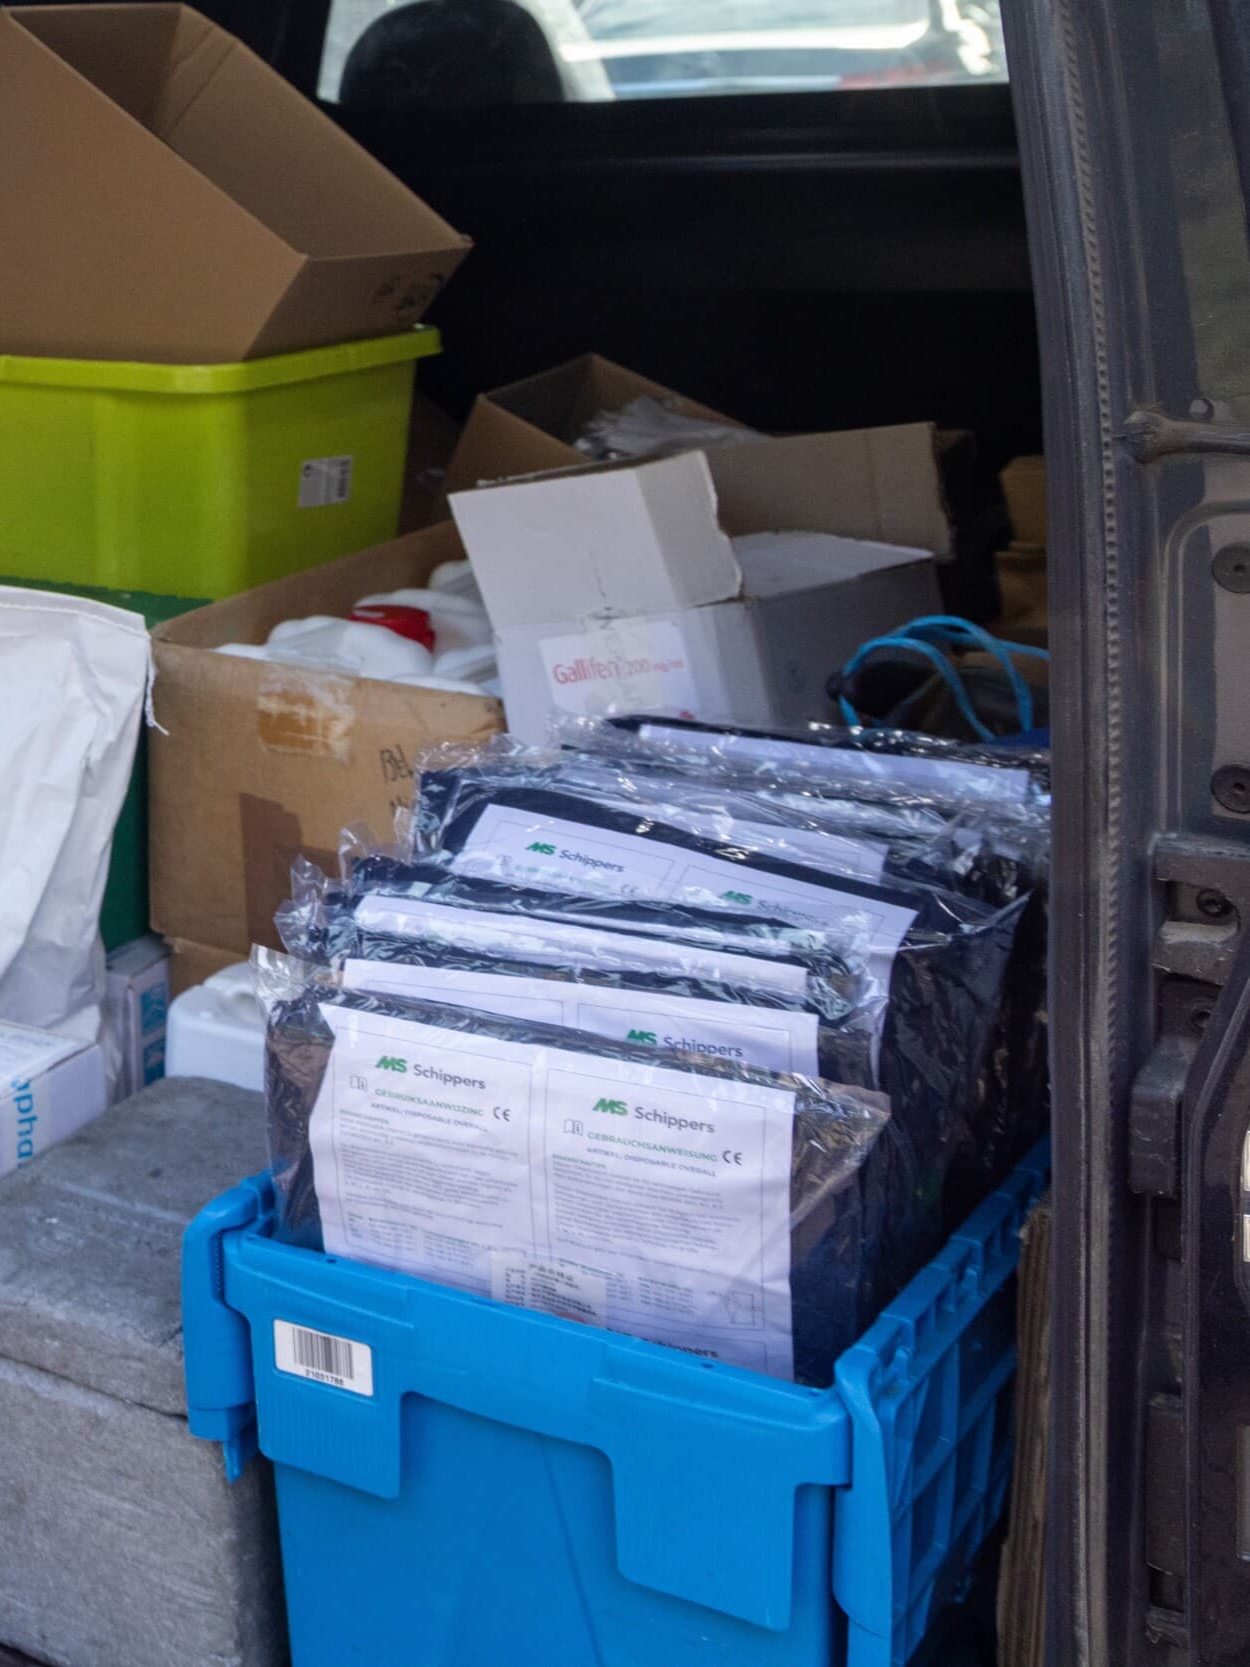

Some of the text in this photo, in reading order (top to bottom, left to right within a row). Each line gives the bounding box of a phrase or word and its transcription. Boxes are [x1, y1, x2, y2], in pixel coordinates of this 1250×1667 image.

[526, 841, 626, 873] MS Schippers
[719, 890, 753, 906] MS
[626, 1029, 743, 1058] MS Schippers
[375, 1055, 487, 1090] MS Schippers
[592, 1097, 716, 1134] MS Schippers
